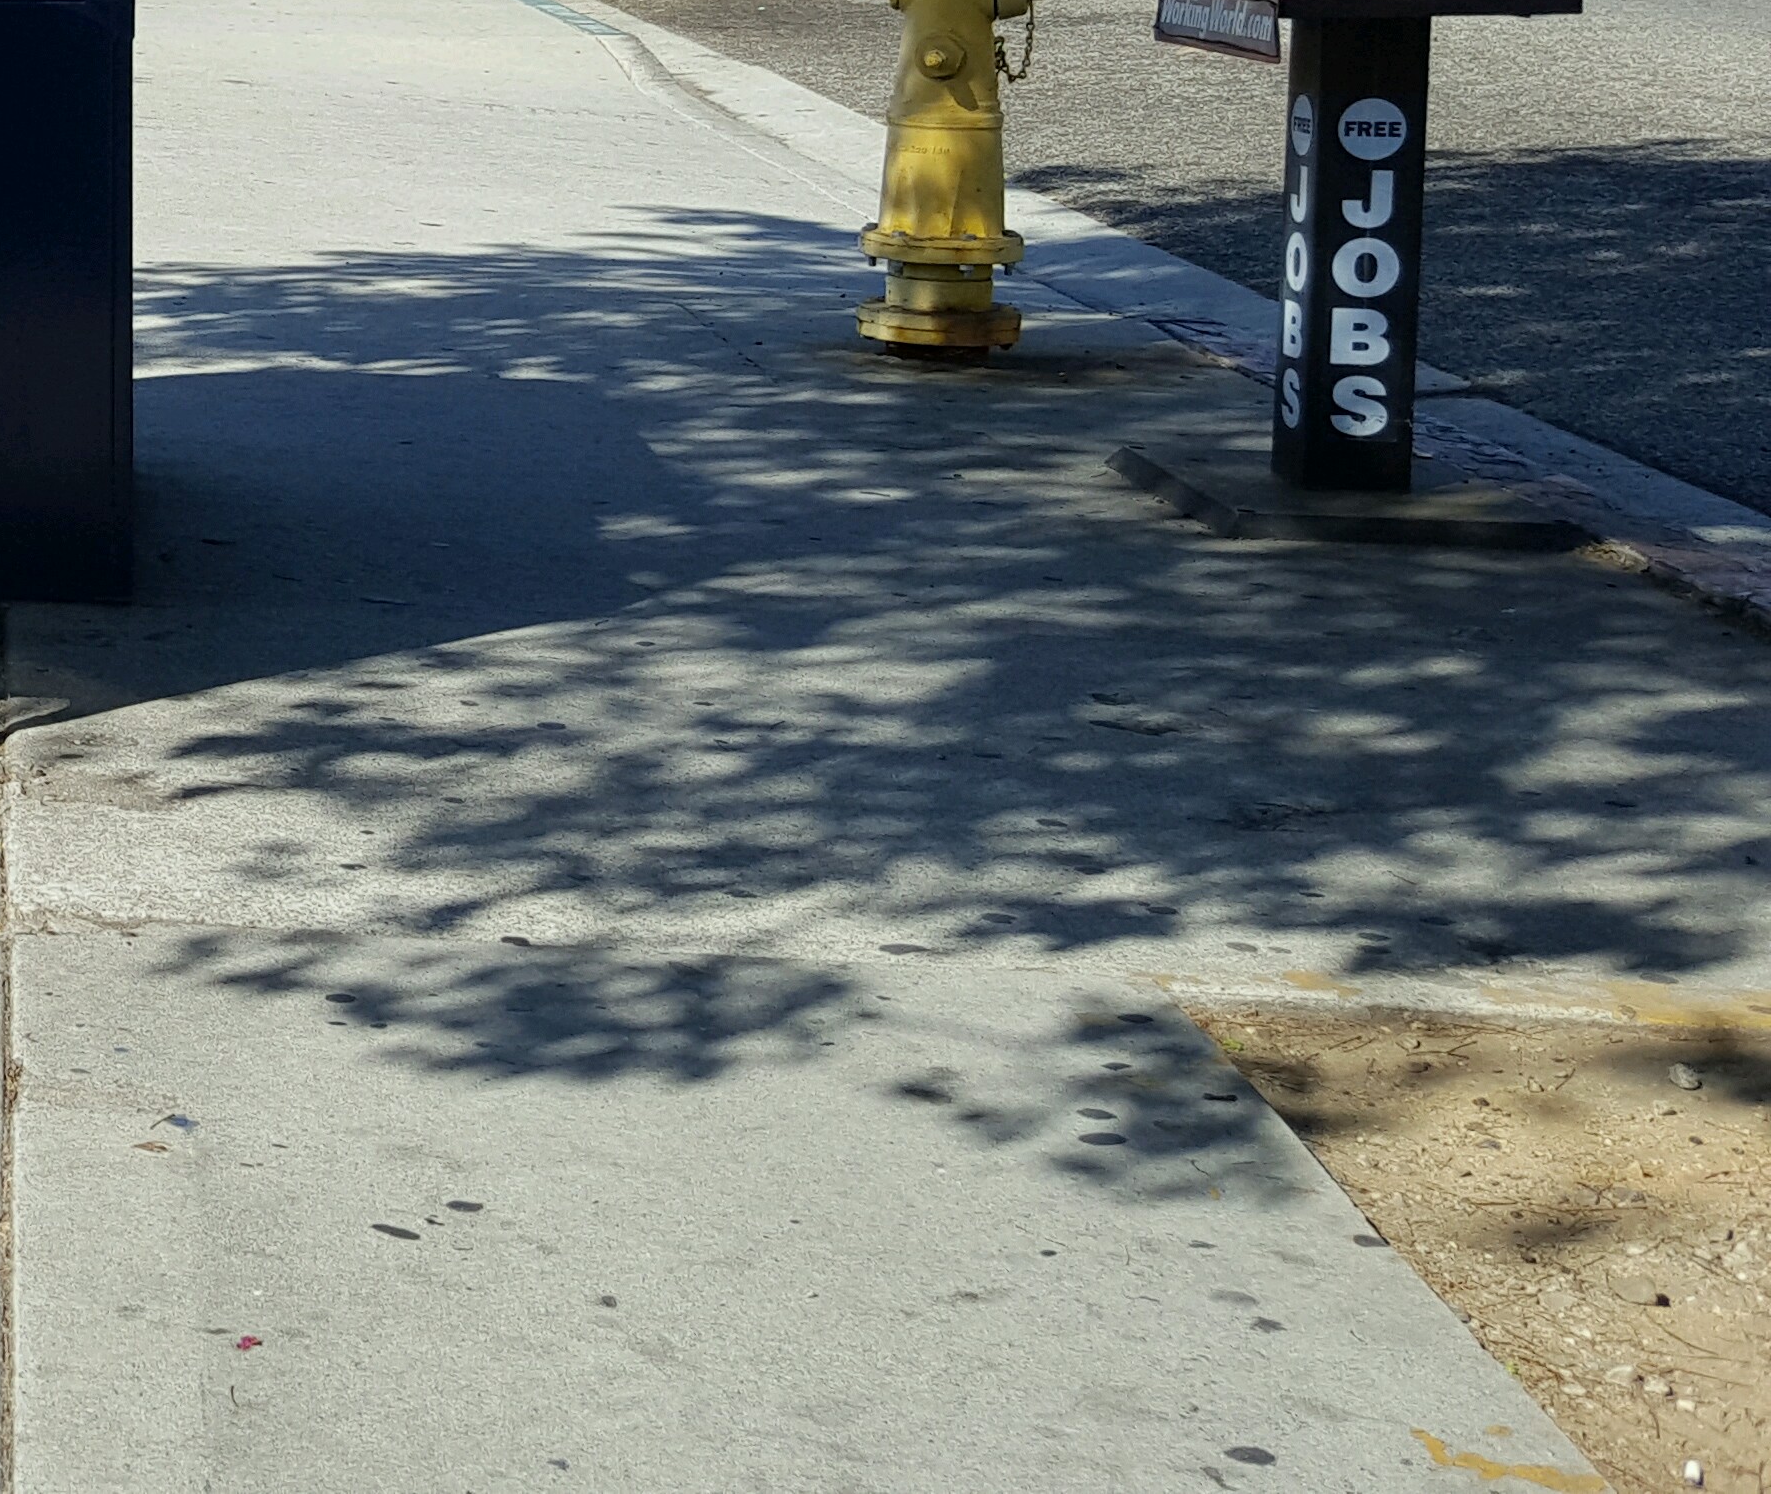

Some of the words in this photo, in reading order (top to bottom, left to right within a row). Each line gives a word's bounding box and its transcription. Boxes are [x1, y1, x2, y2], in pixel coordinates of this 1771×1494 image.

[1293, 116, 1311, 134] FREE
[1344, 120, 1402, 138] FREE
[1281, 165, 1309, 428] JOBS
[1329, 169, 1400, 437] JOBS
